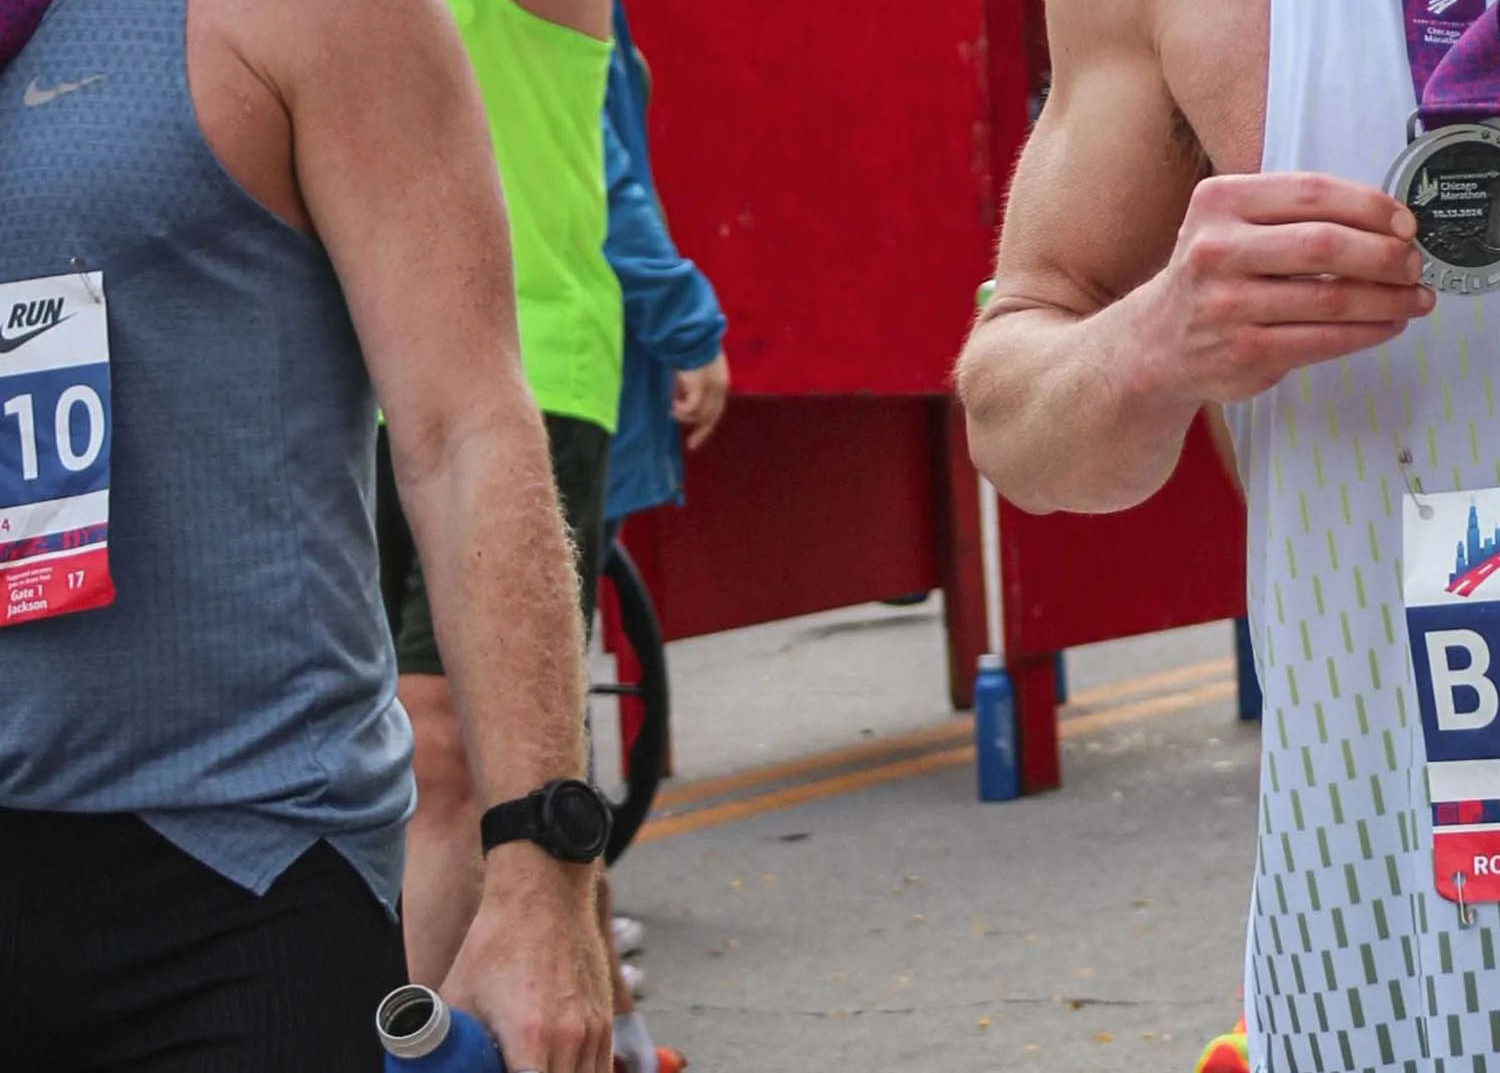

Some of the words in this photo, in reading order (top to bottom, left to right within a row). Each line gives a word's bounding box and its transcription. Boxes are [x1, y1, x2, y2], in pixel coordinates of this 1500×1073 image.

[8, 297, 64, 328] RUN
[67, 570, 85, 590] 17
[10, 588, 34, 602] Gate
[38, 584, 43, 596] 1
[7, 599, 48, 619] Jackson
[1424, 628, 1500, 732] B
